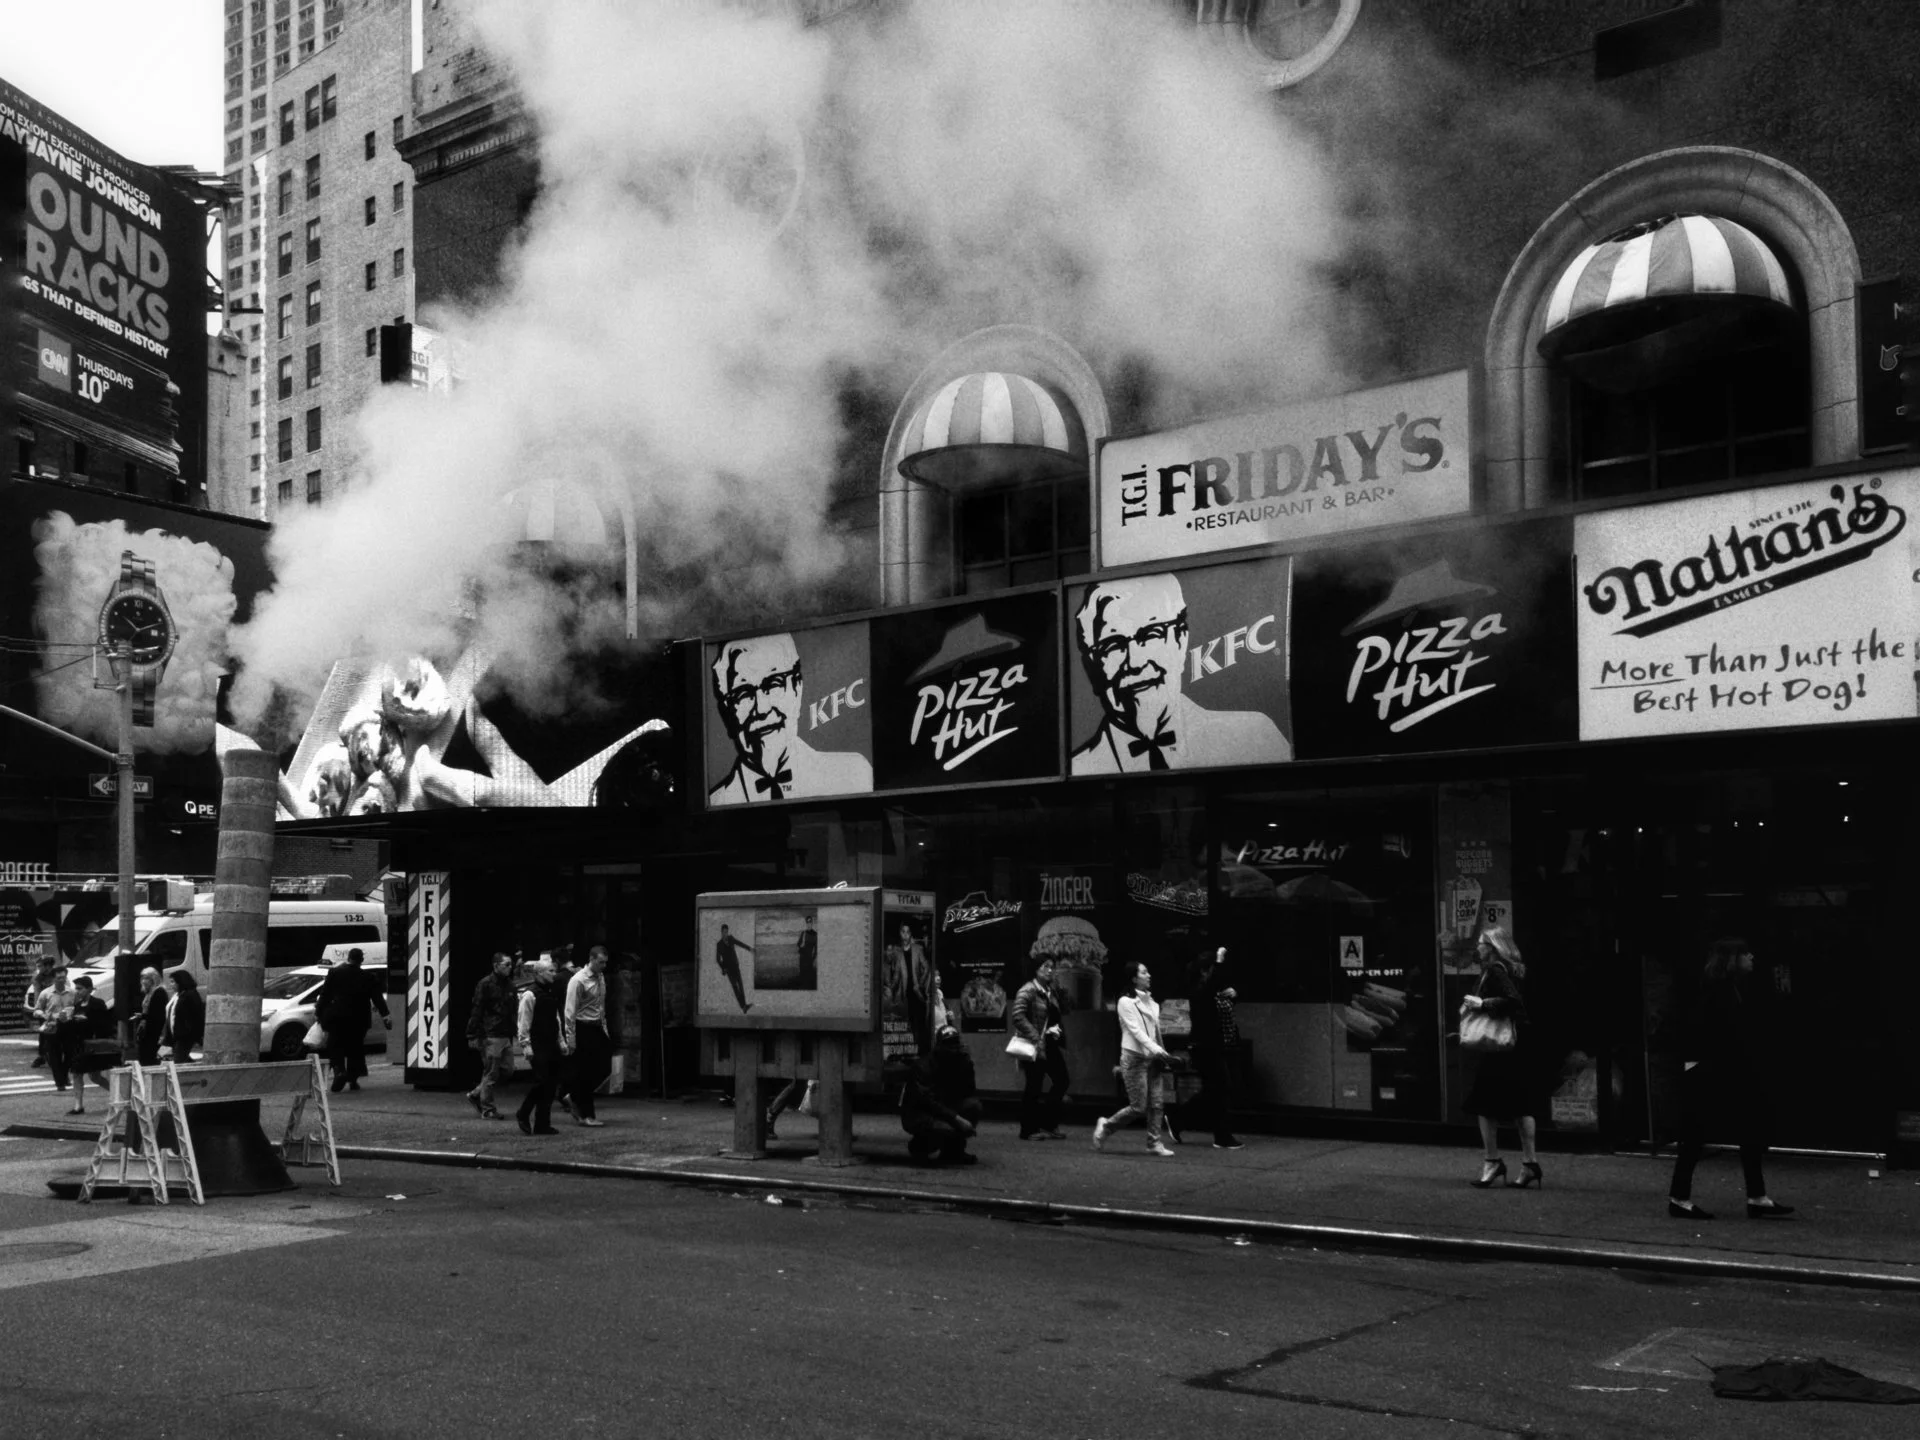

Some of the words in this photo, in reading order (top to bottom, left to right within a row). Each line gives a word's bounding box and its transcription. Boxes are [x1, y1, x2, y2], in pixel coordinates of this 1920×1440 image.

[51, 134, 102, 175] EXECUTIVE
[103, 167, 151, 205] PRODUCER
[85, 171, 161, 231] JOHNSON
[29, 171, 169, 289] OUND
[26, 223, 170, 341] RACKS
[21, 275, 40, 294] GS
[41, 283, 73, 311] THAT
[75, 301, 123, 336] DEFINED
[124, 327, 170, 359] HISTORY
[41, 348, 69, 377] CNN
[77, 353, 134, 390] THURSDAYS
[1157, 411, 1446, 519] FRIDAY'S
[1194, 497, 1314, 532] RESTAURANT
[1322, 495, 1338, 510] &
[1344, 486, 1385, 508] BAR
[1583, 484, 1890, 621] Nathan's
[1190, 615, 1277, 683] KFC
[1347, 613, 1507, 703] Pizza
[1601, 660, 1674, 684] More
[1685, 642, 1767, 675] Than
[1775, 641, 1842, 673] Just
[1852, 628, 1905, 665] the
[809, 679, 865, 731] KFC
[910, 664, 1028, 745] Pizza
[1374, 651, 1491, 721] Hut
[1634, 688, 1698, 714] Best
[1709, 682, 1772, 709] Hot
[1783, 673, 1867, 711] Dog!
[931, 698, 1016, 760] Hut
[102, 781, 116, 791] ON
[199, 805, 216, 815] PE
[1236, 840, 1299, 864] Pizza
[898, 894, 921, 905] TITAN
[16, 943, 42, 955] GLAM
[1344, 939, 1359, 958] A
[1346, 969, 1364, 977] TOP
